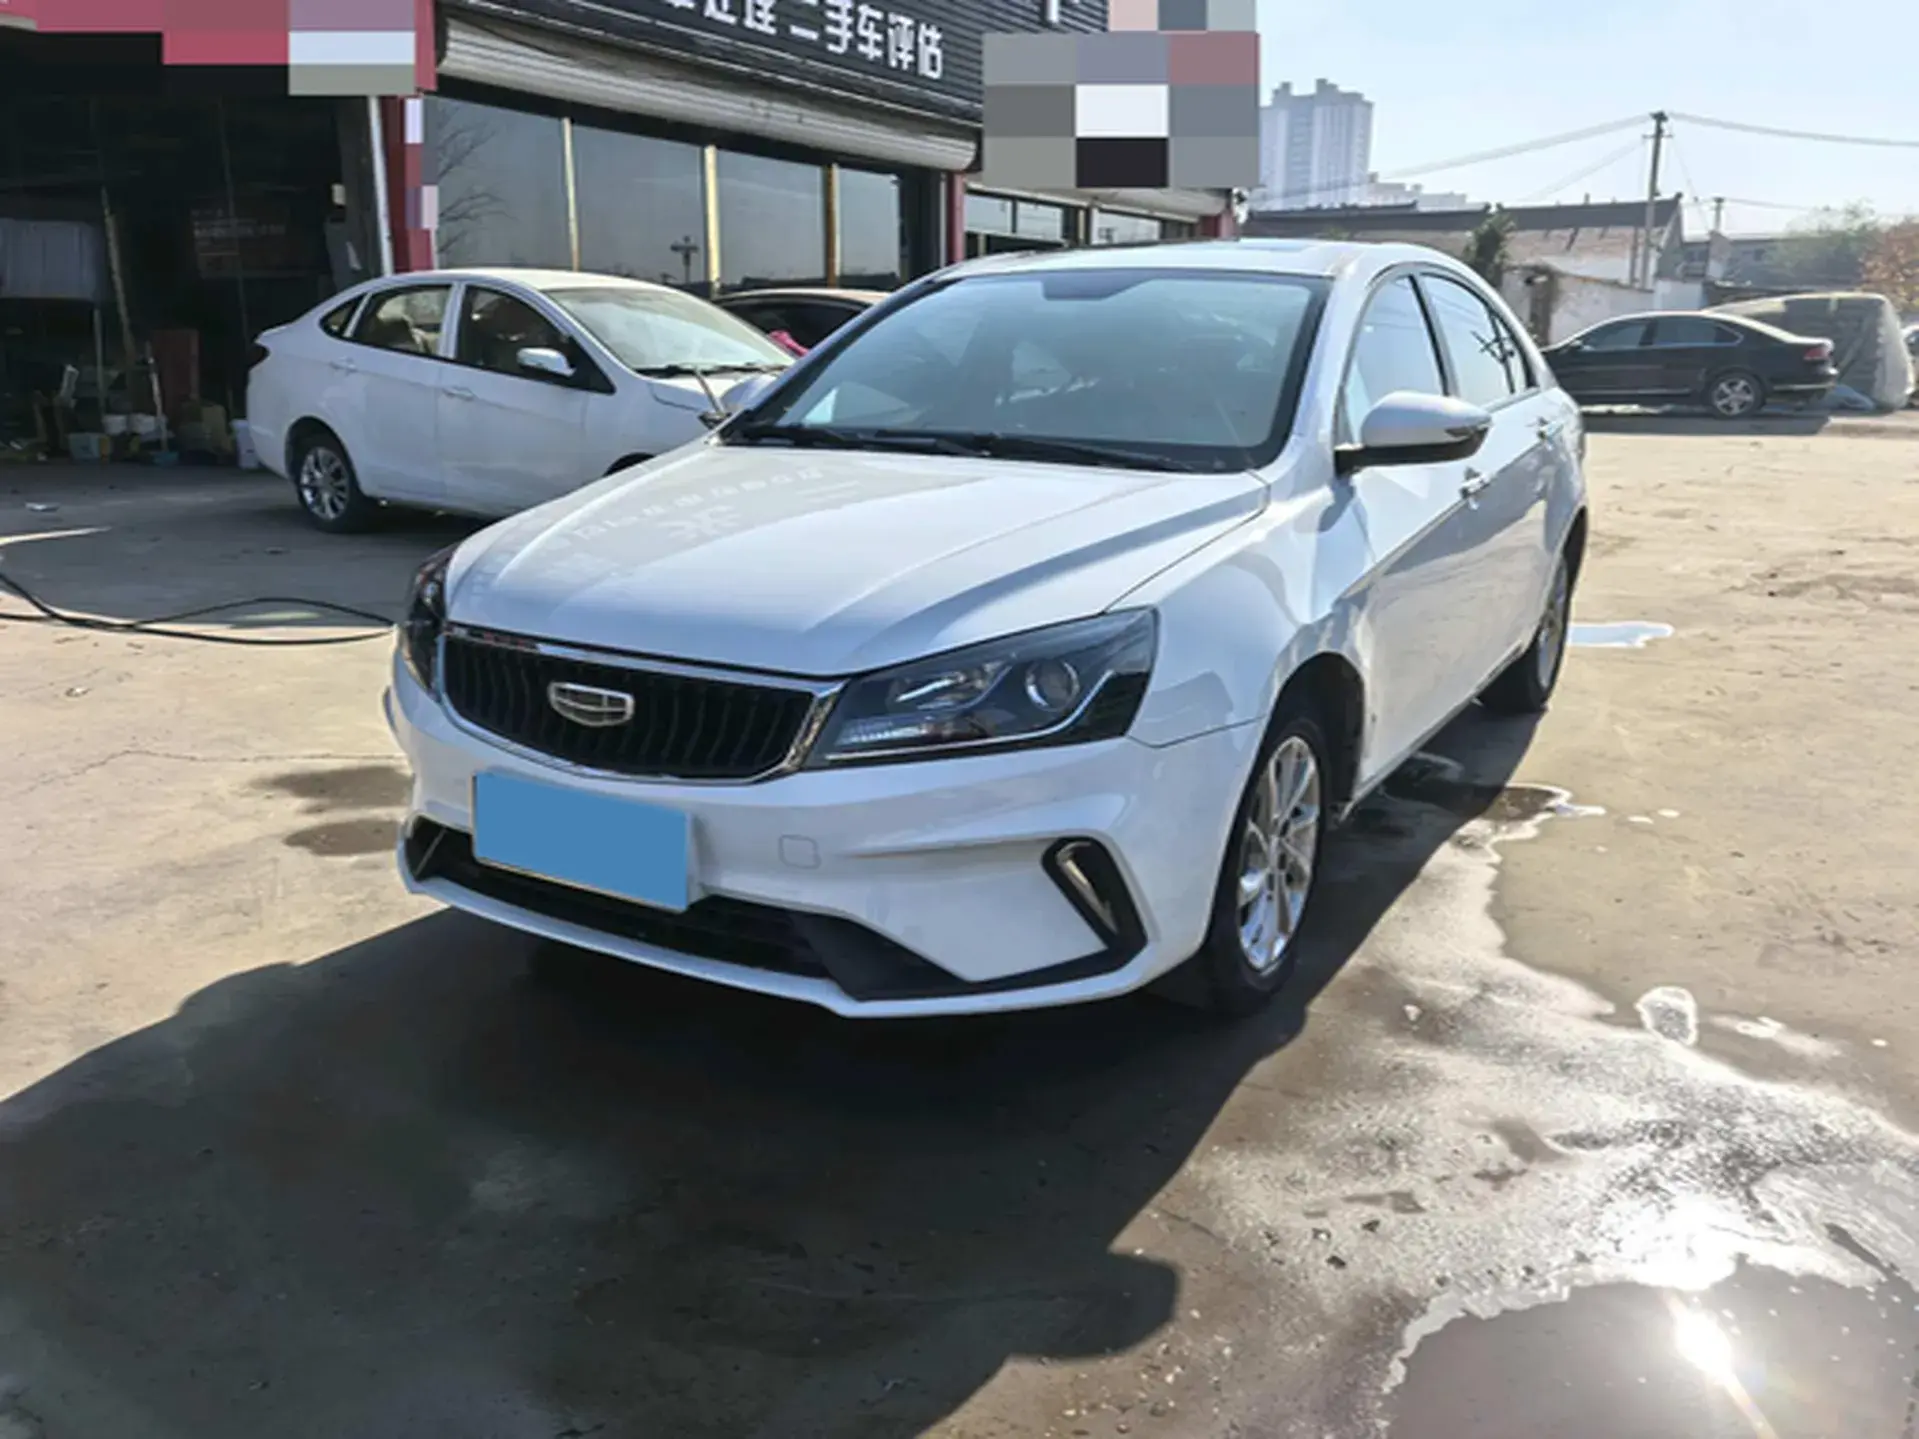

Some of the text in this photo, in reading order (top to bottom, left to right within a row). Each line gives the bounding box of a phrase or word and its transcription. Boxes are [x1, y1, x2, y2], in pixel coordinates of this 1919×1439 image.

[664, 0, 943, 79] 二手车评估
